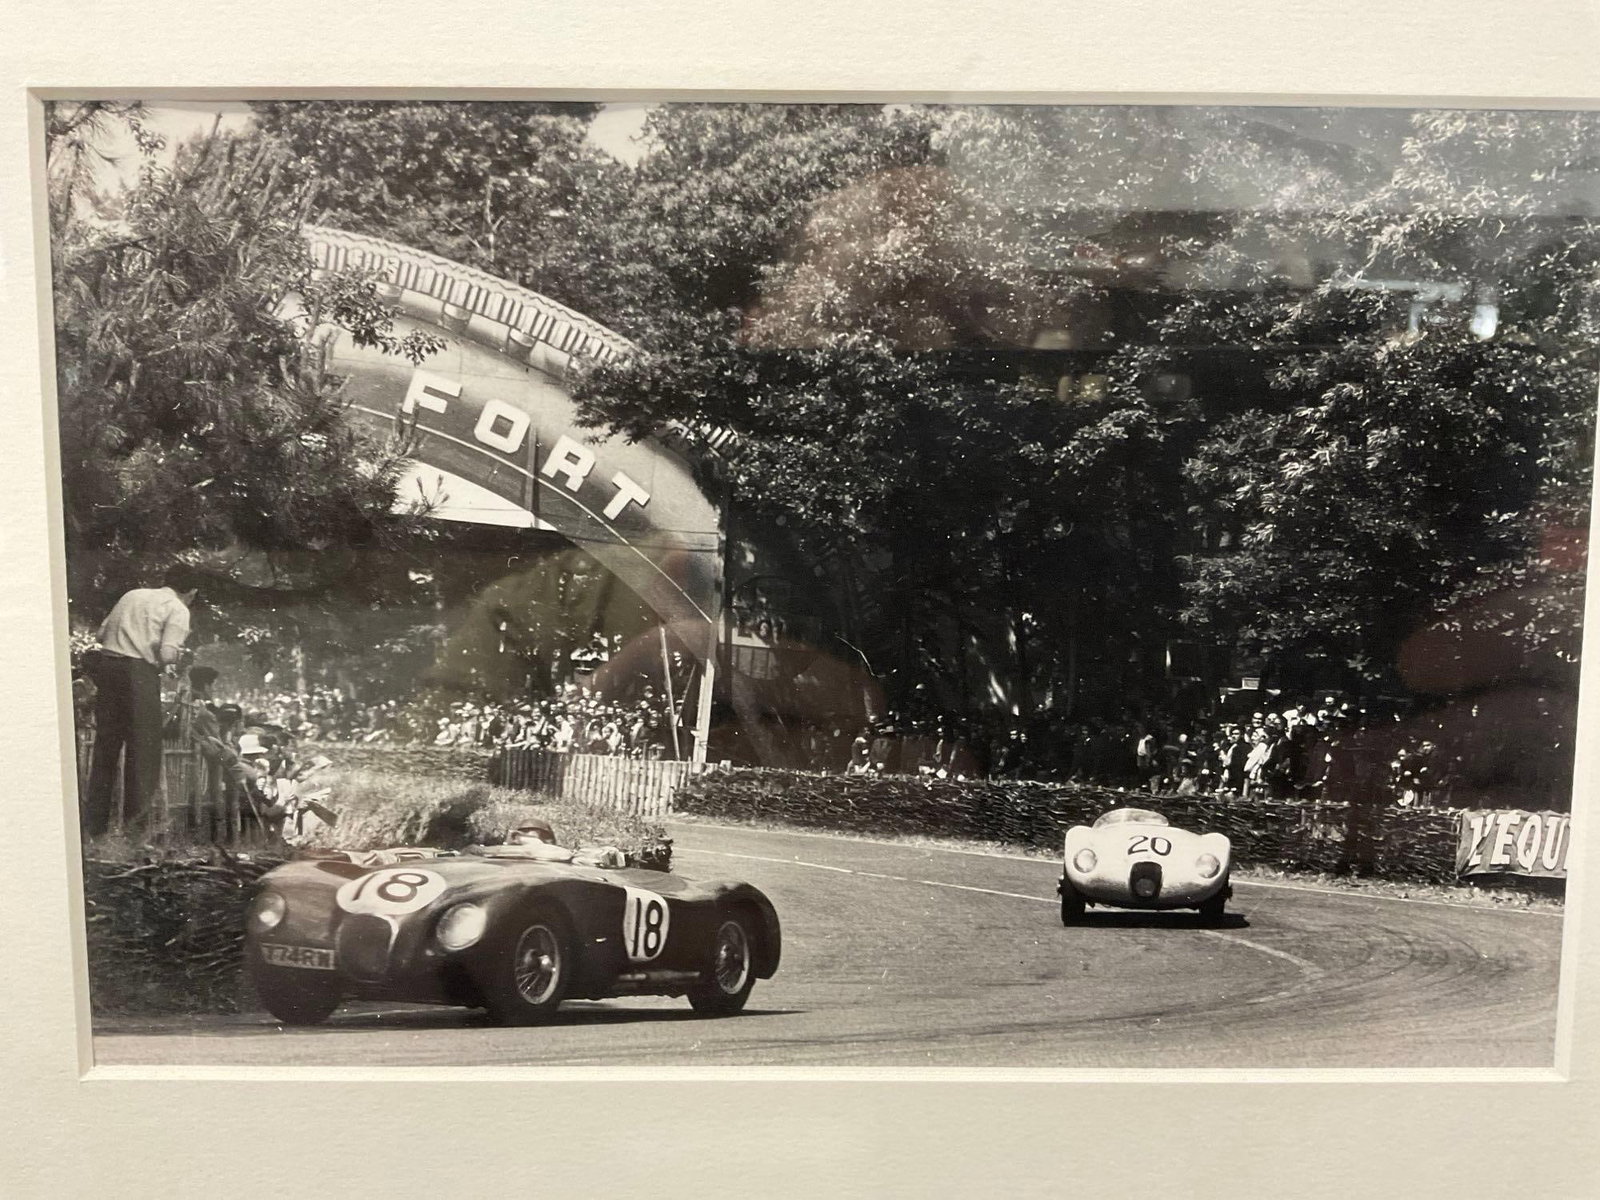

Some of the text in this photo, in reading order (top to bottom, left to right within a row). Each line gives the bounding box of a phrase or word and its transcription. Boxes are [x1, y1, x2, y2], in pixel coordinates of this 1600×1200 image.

[402, 369, 650, 521] FORT
[1127, 835, 1172, 856] 20
[1468, 813, 1571, 875] L'EQU
[352, 872, 429, 903] 18
[631, 897, 663, 958] 18
